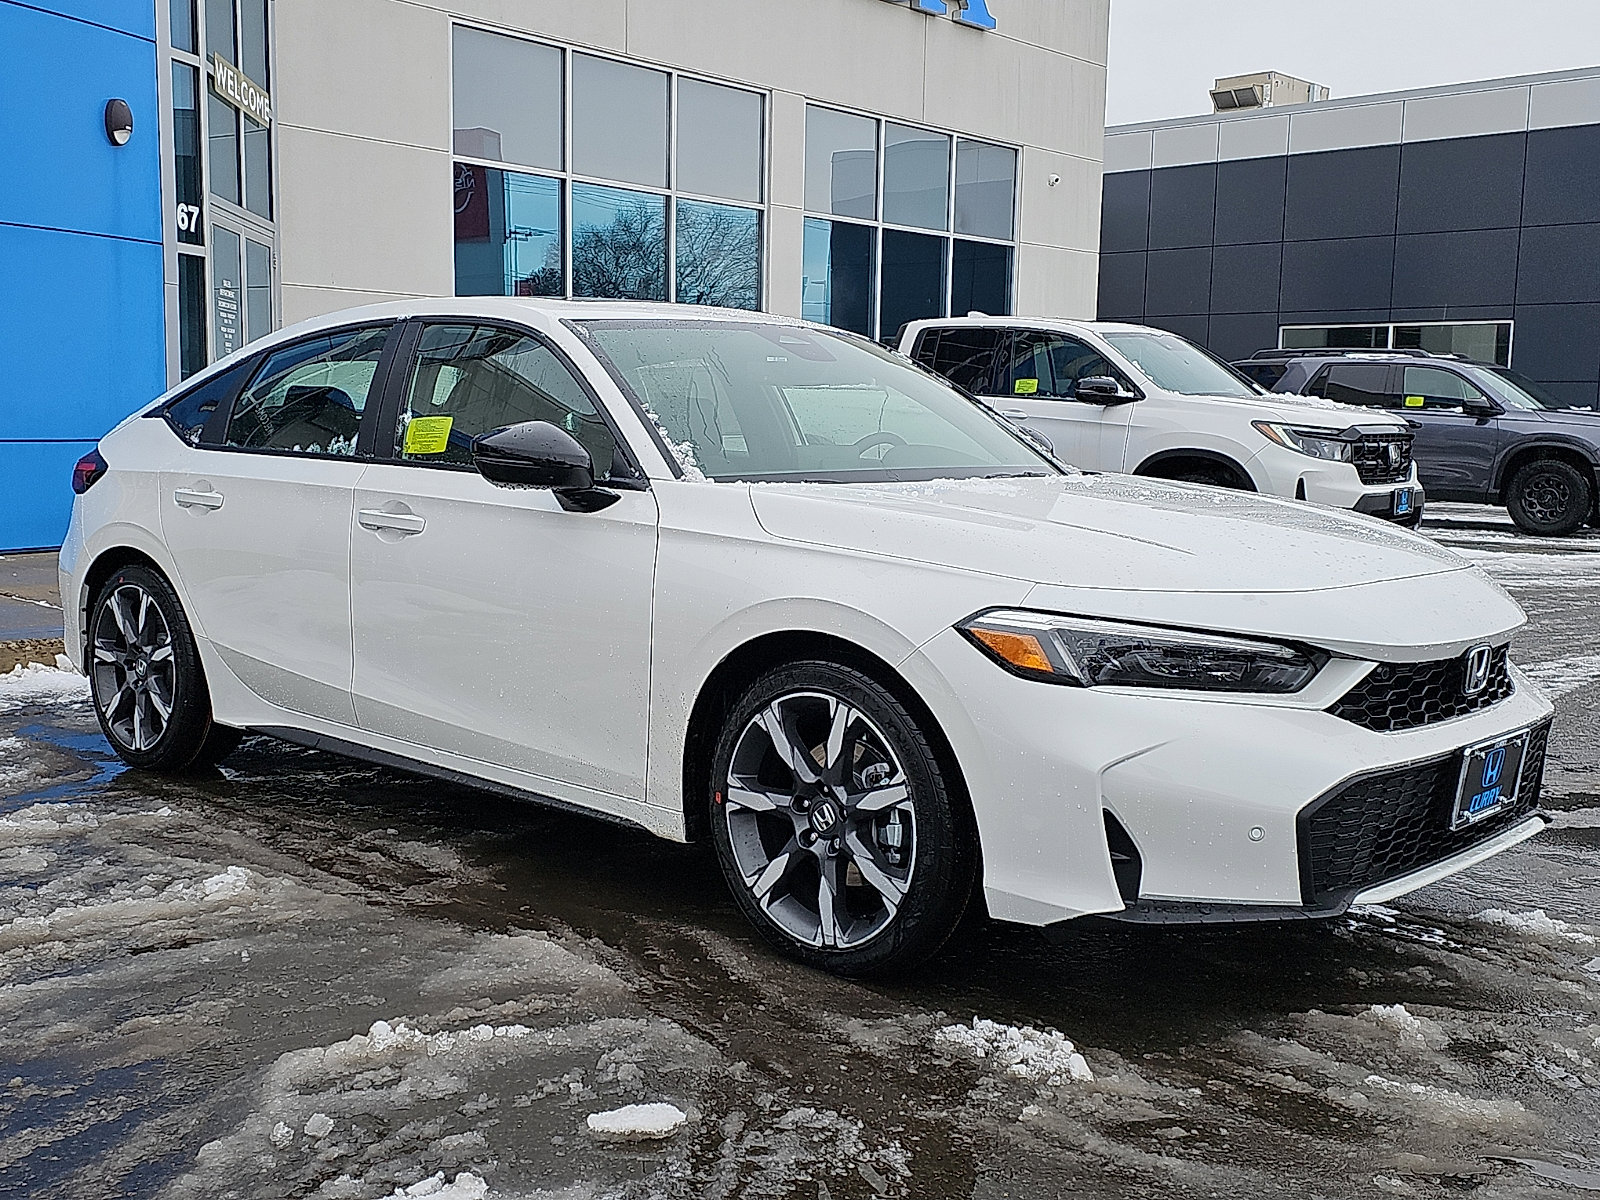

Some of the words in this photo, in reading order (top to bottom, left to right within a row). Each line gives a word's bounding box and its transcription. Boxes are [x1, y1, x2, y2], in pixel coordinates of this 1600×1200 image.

[214, 58, 271, 122] WELCOME
[177, 202, 200, 233] 67
[1469, 785, 1503, 812] CURRY
